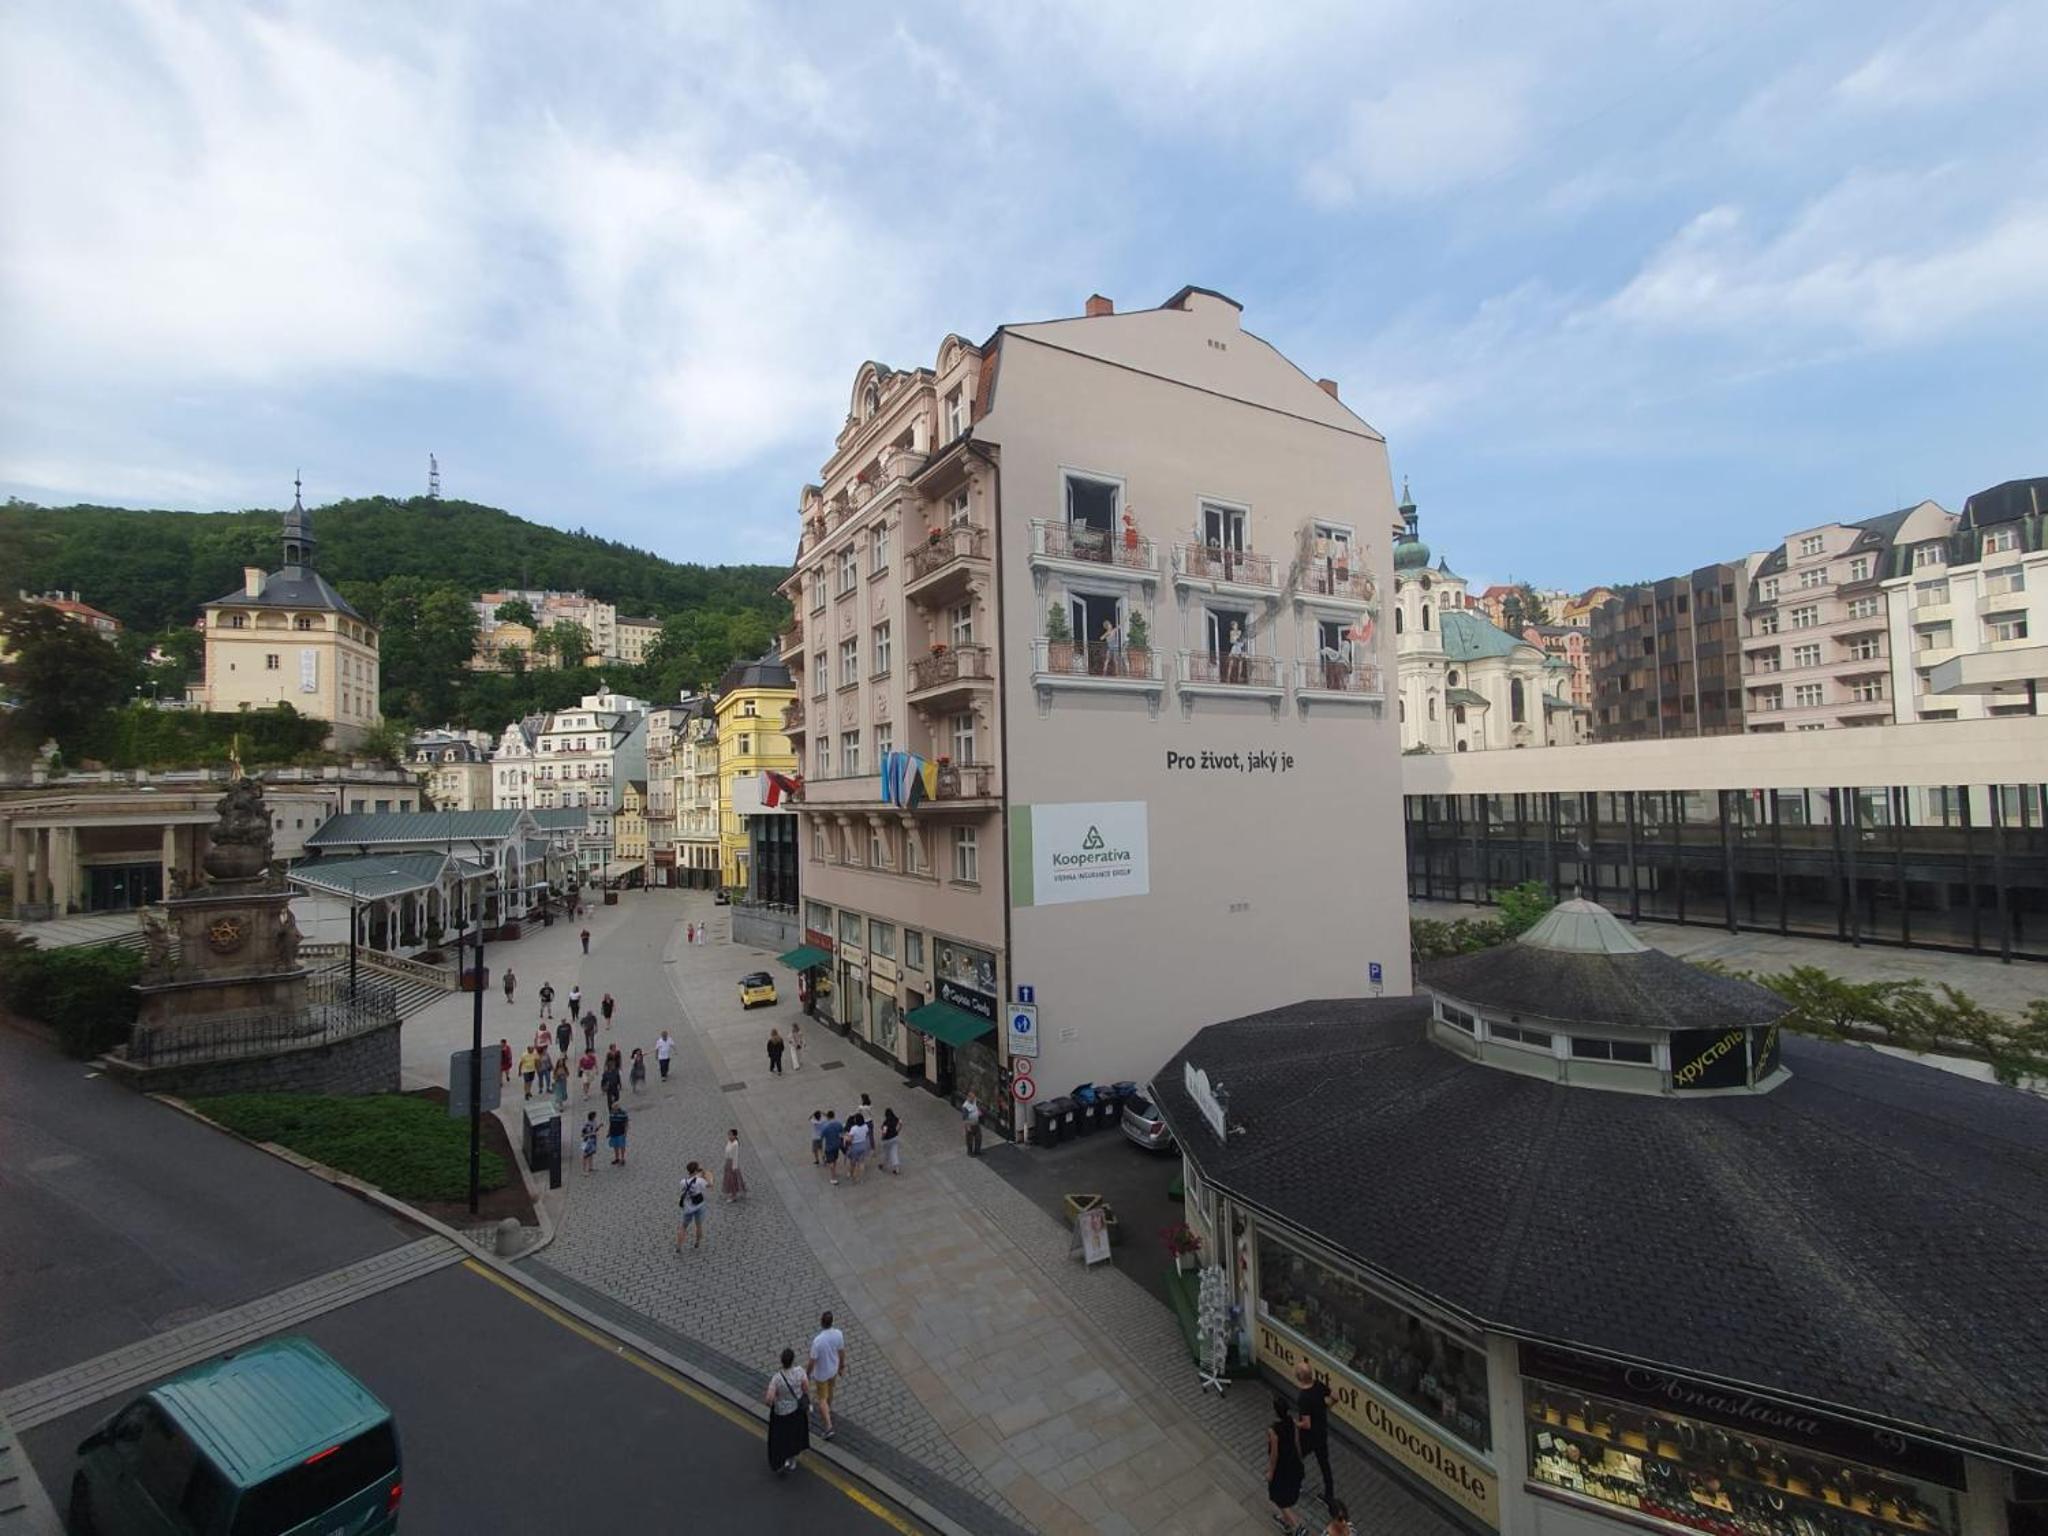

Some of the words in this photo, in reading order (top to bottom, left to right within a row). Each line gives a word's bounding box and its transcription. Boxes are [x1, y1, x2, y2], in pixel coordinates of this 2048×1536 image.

[1166, 751, 1195, 770] Pro
[1201, 749, 1244, 772] život,
[1248, 750, 1277, 772] jaký
[1281, 752, 1294, 772] je
[1052, 848, 1131, 867] Kooperativa
[1371, 964, 1379, 976] P
[1260, 1328, 1294, 1367] The
[1338, 1386, 1359, 1411] of
[1366, 1400, 1486, 1500] Chocolate
